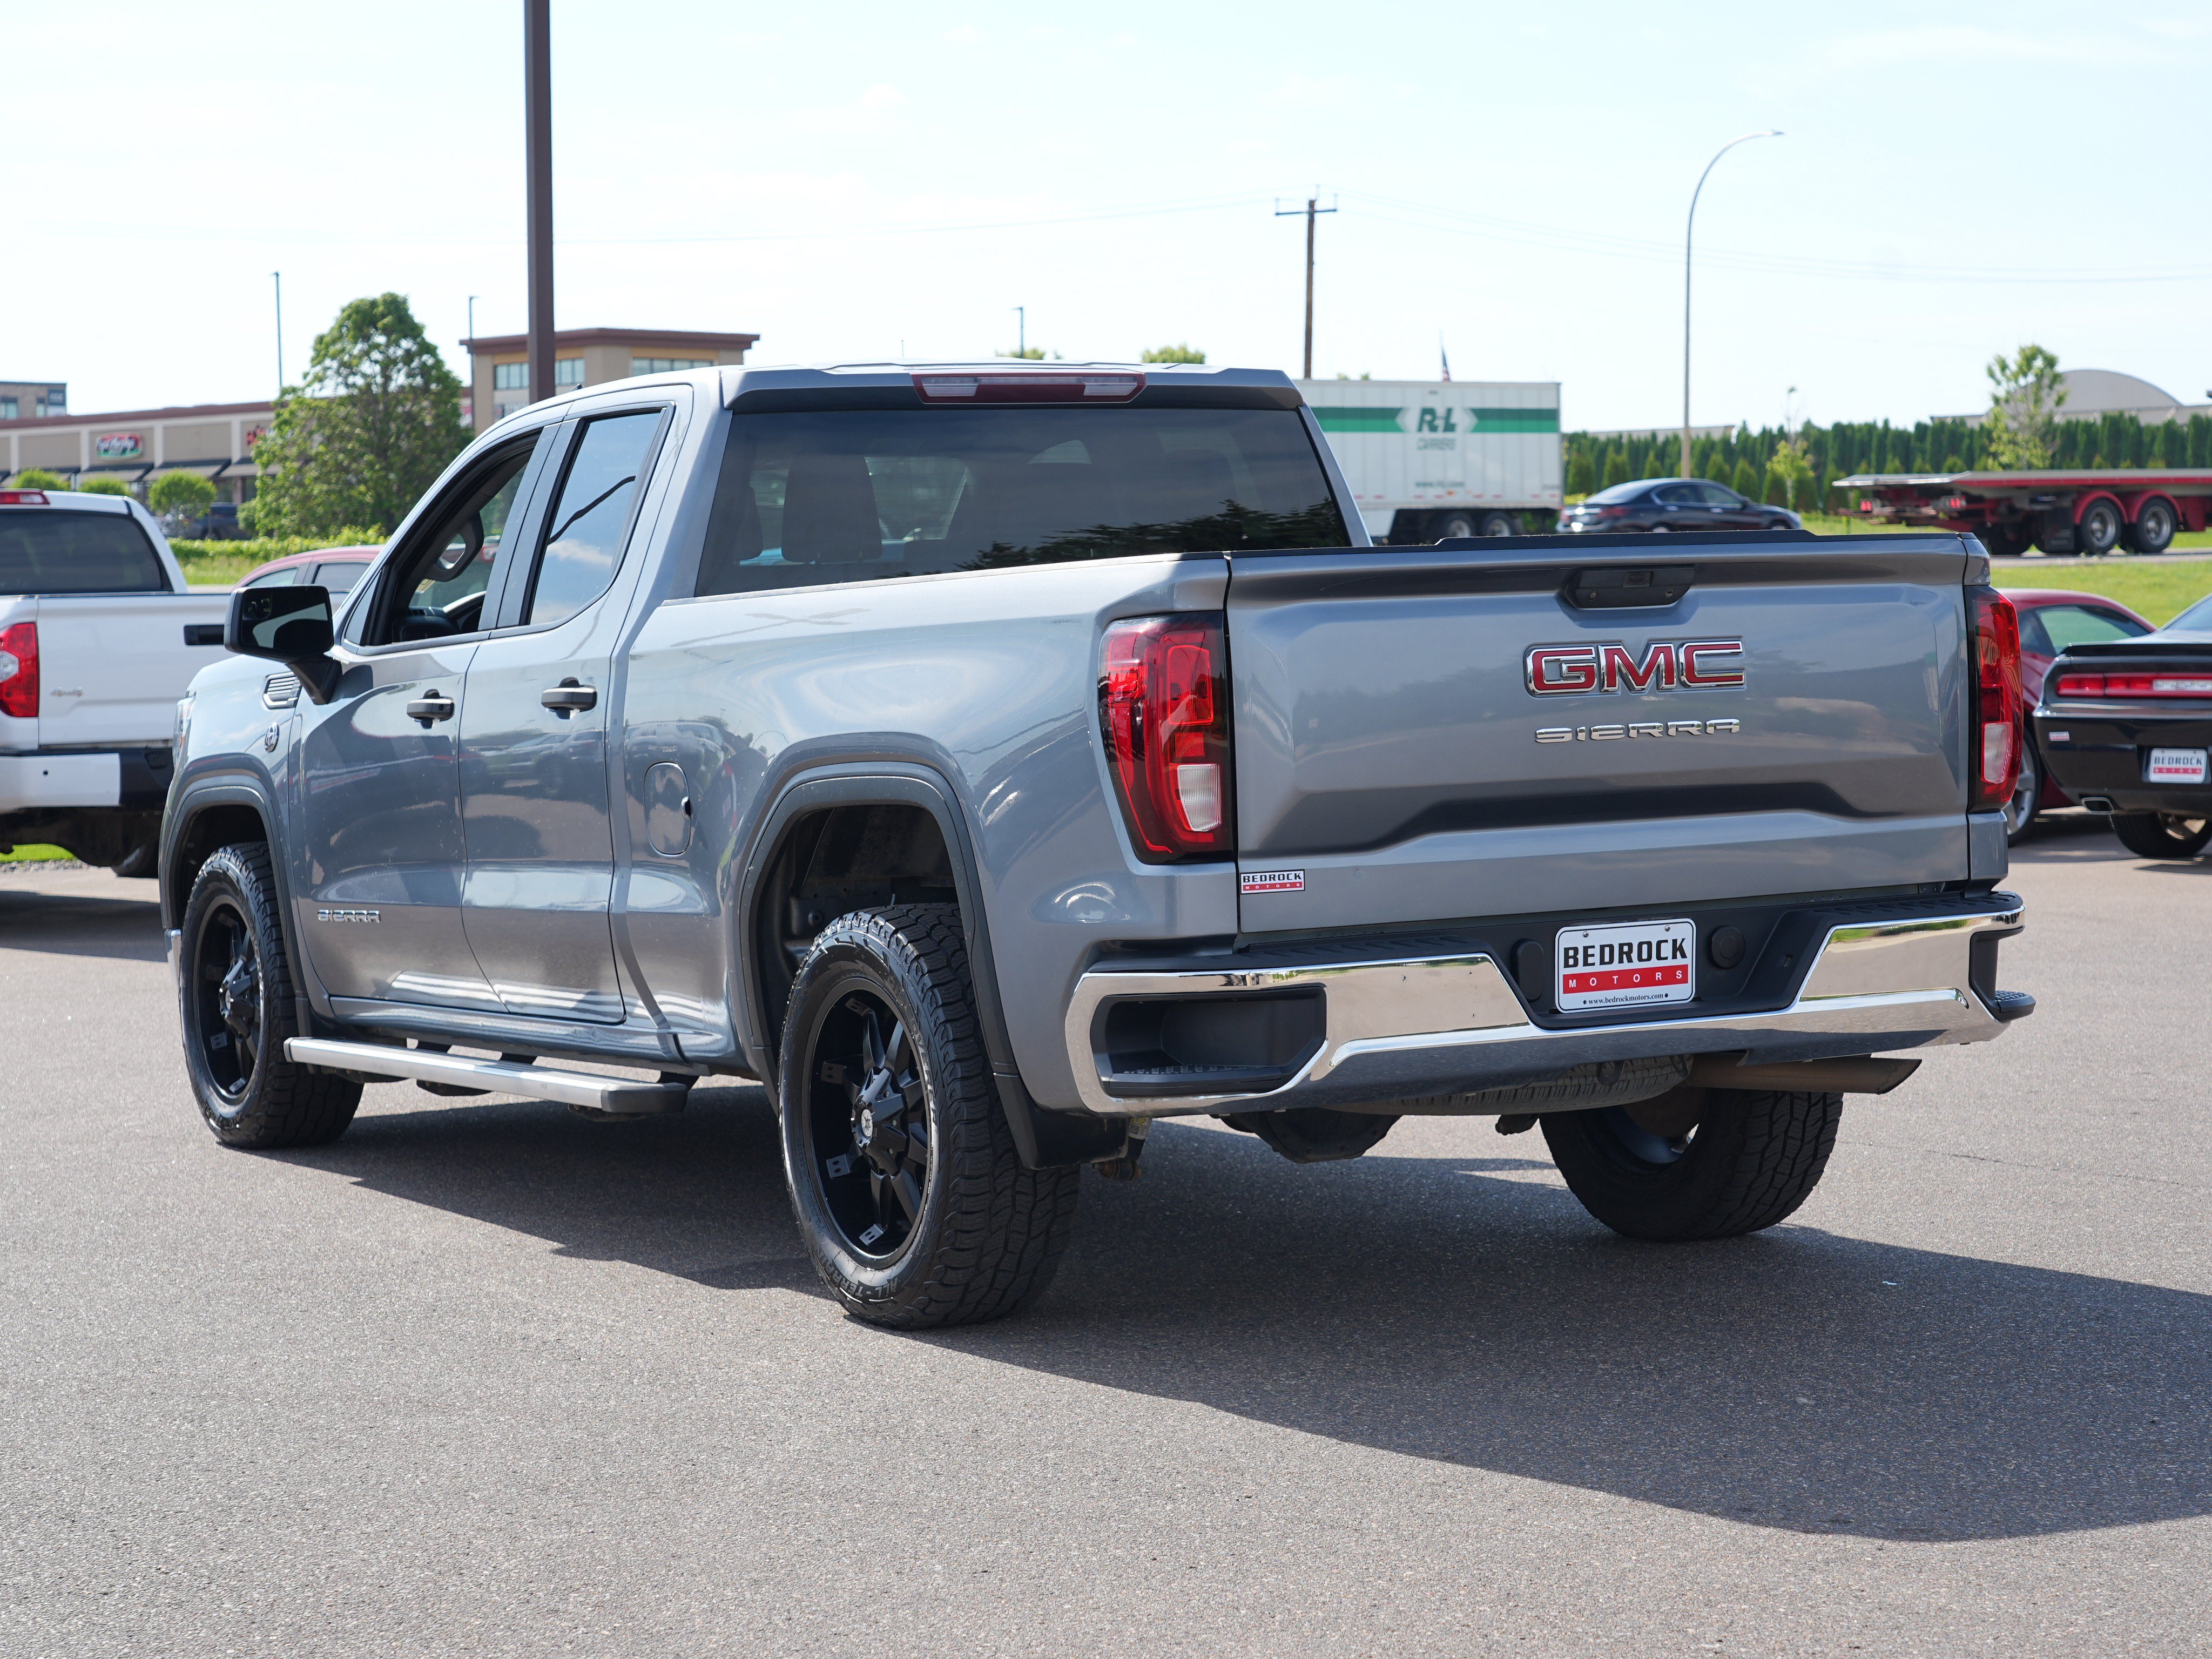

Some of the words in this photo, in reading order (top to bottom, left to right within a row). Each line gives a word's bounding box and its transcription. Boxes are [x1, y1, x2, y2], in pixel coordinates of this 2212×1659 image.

[1526, 640, 1745, 694] GMC
[1535, 718, 1740, 744] SIERRA
[2154, 757, 2202, 765] BEDROCK
[1243, 873, 1301, 883] BEDROCK
[318, 909, 381, 923] SIERRA
[1563, 938, 1688, 968] BEDROCK
[1569, 970, 1683, 988] MOTORS
[1588, 993, 1664, 1004] www.bedrockmotors.com
